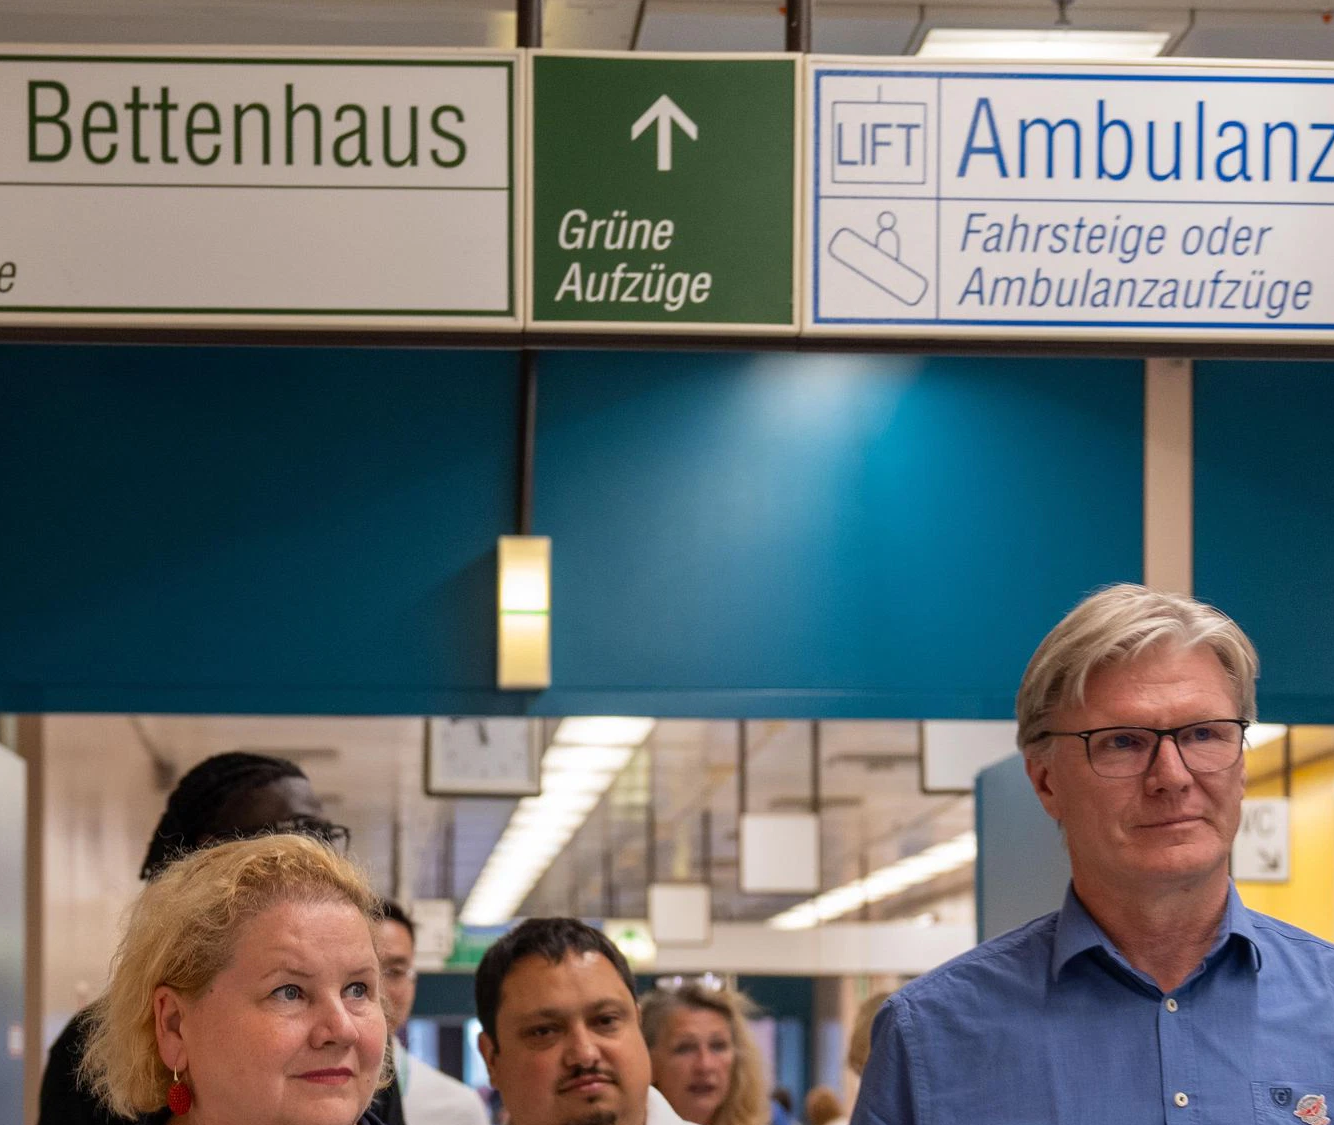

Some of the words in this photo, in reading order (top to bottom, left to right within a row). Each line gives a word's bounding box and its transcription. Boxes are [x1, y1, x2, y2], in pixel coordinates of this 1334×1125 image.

[26, 79, 467, 169] Bettenhaus
[836, 122, 921, 166] LIFT
[556, 207, 675, 252] Grüne
[961, 212, 1166, 265] Fahrsteige
[1181, 217, 1273, 256] oder
[554, 261, 713, 312] Aufzüge
[957, 265, 1314, 319] Ambulanzaufzüge
